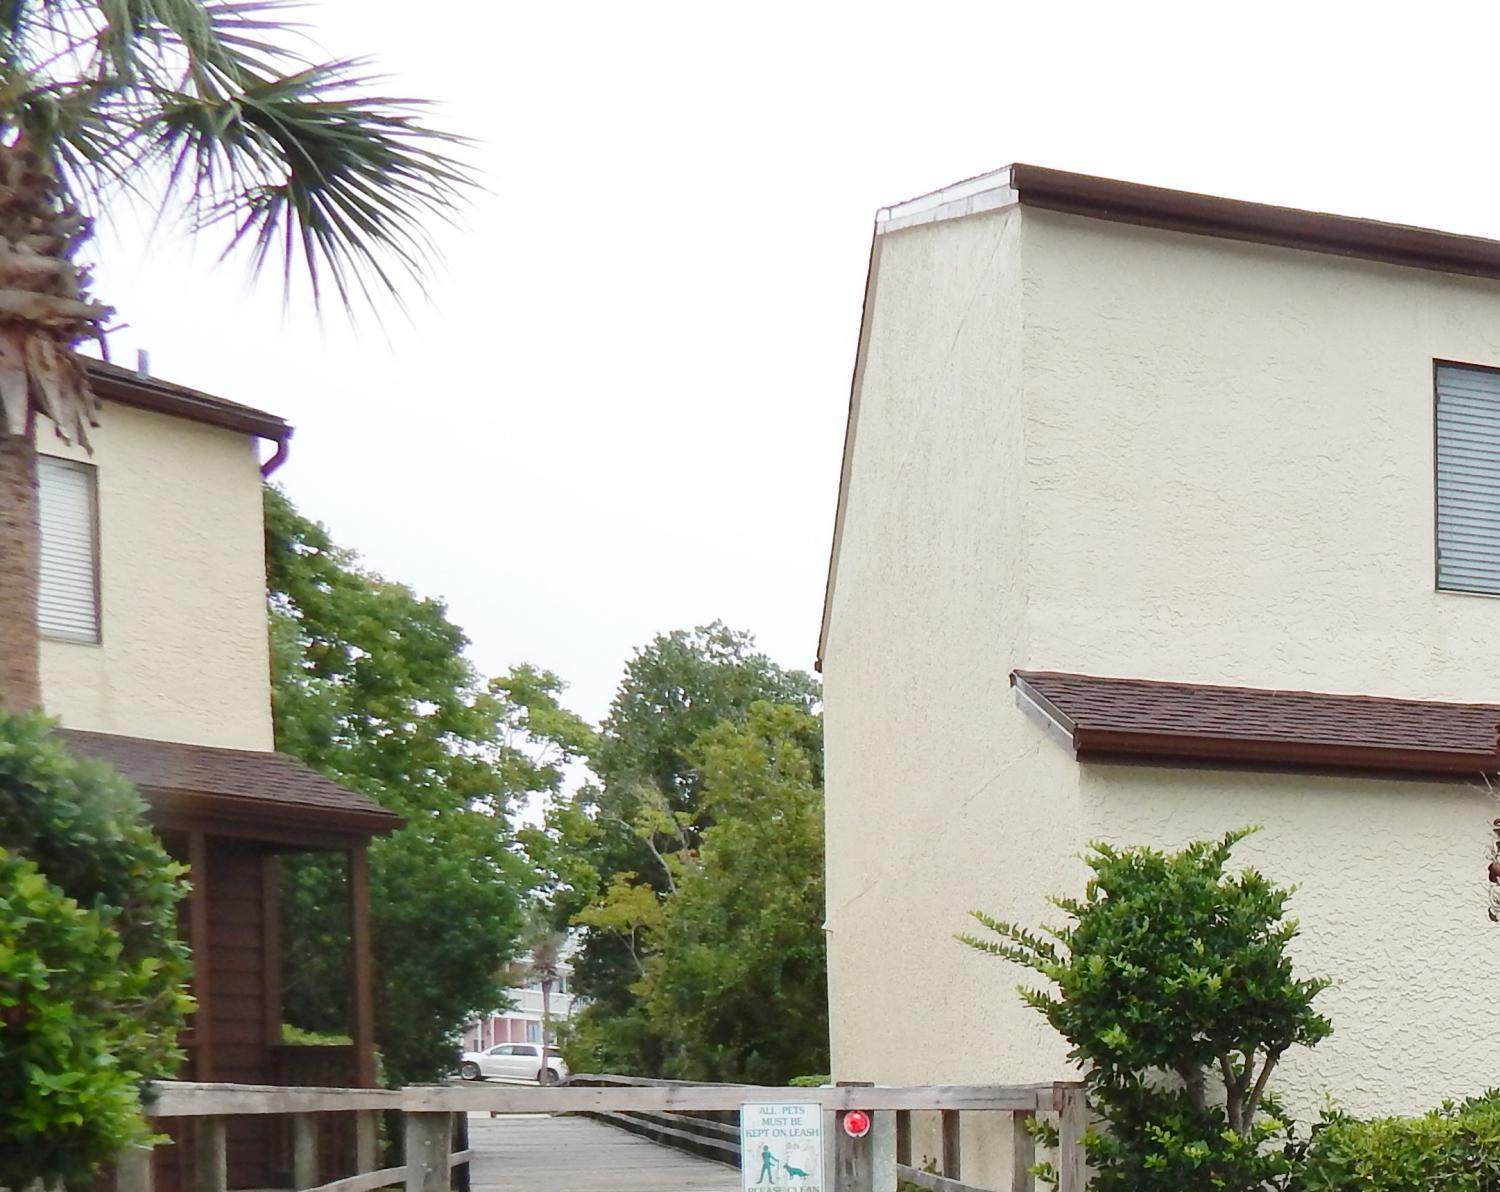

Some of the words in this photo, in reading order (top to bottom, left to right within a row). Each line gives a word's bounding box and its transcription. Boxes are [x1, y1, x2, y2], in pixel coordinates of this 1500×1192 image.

[759, 1106, 777, 1115] ALL
[782, 1106, 805, 1115] PETS
[762, 1117, 788, 1126] MUST
[791, 1117, 802, 1126] BE
[746, 1129, 769, 1138] KEPT
[772, 1128, 787, 1137] ON
[789, 1128, 819, 1137] LEASH
